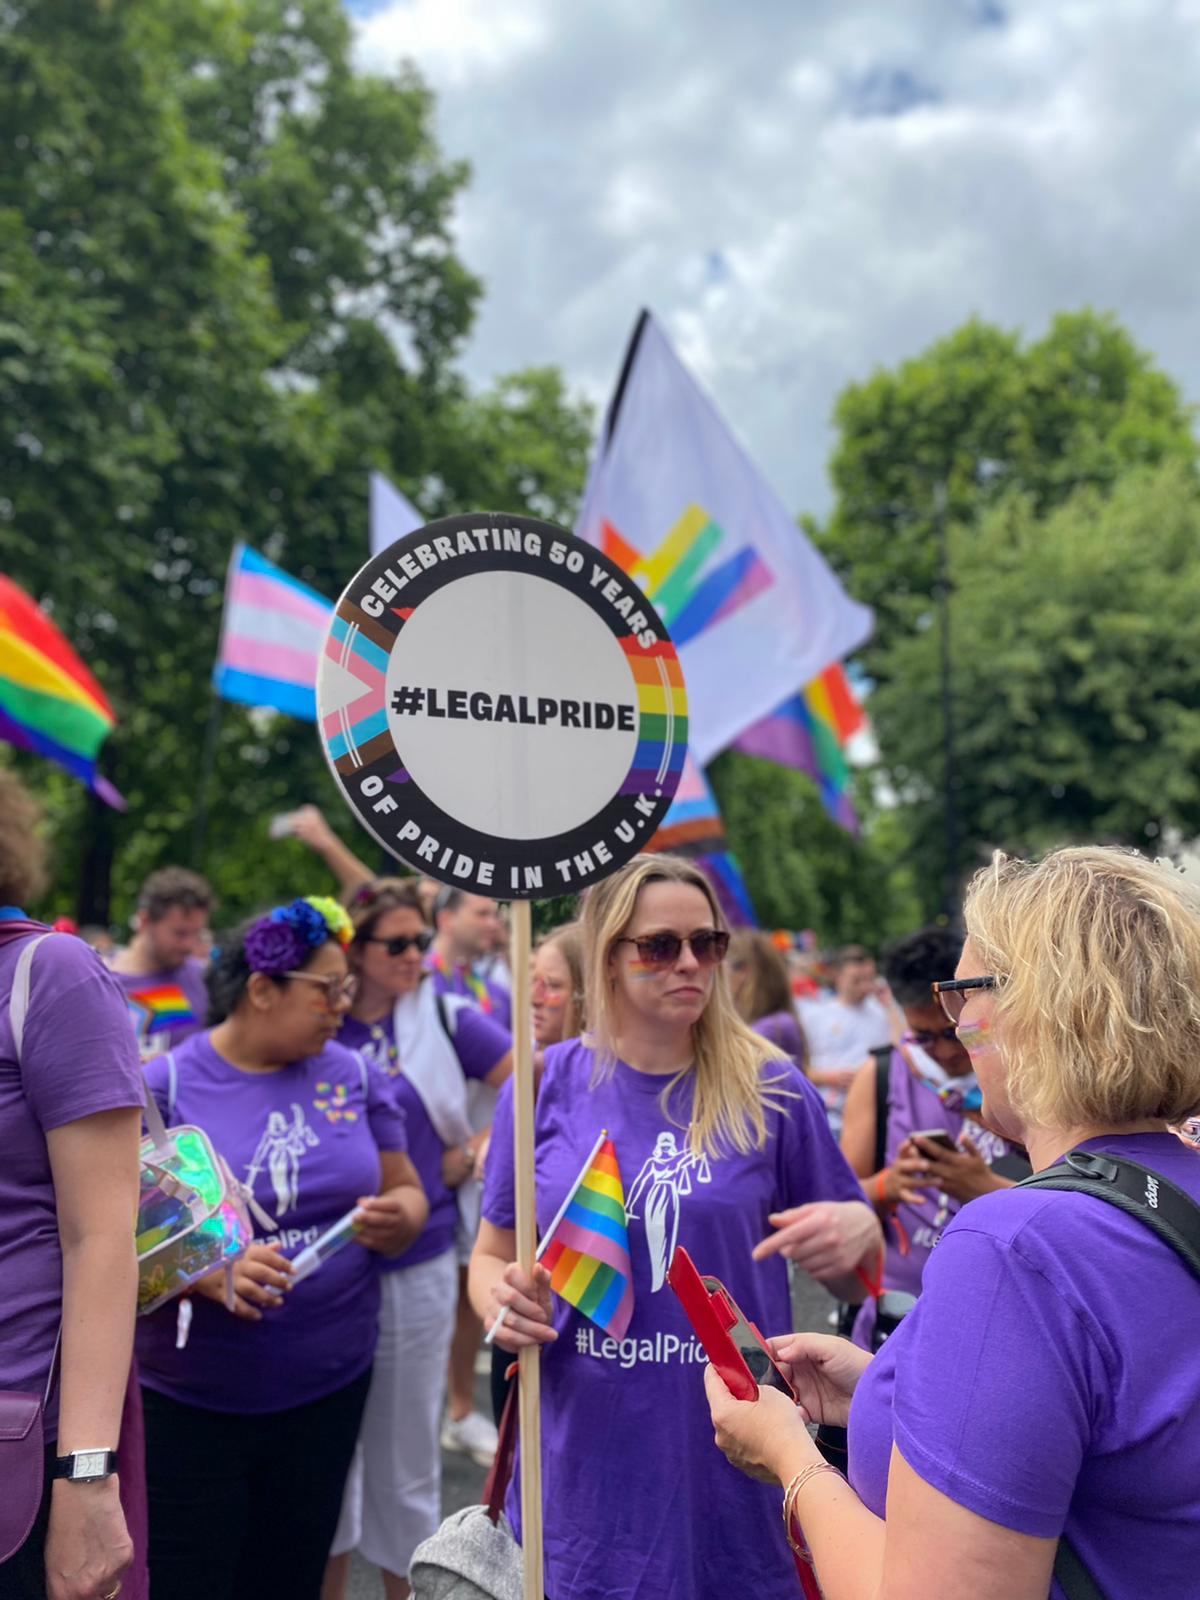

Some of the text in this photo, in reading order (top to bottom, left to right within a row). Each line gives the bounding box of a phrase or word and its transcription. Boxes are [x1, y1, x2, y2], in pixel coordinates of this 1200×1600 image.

[360, 527, 658, 650] CELEBRATING 50 YEARS
[390, 686, 636, 731] #LEGALPRIDE
[360, 775, 663, 888] OF PRIDE IN THE U.K.
